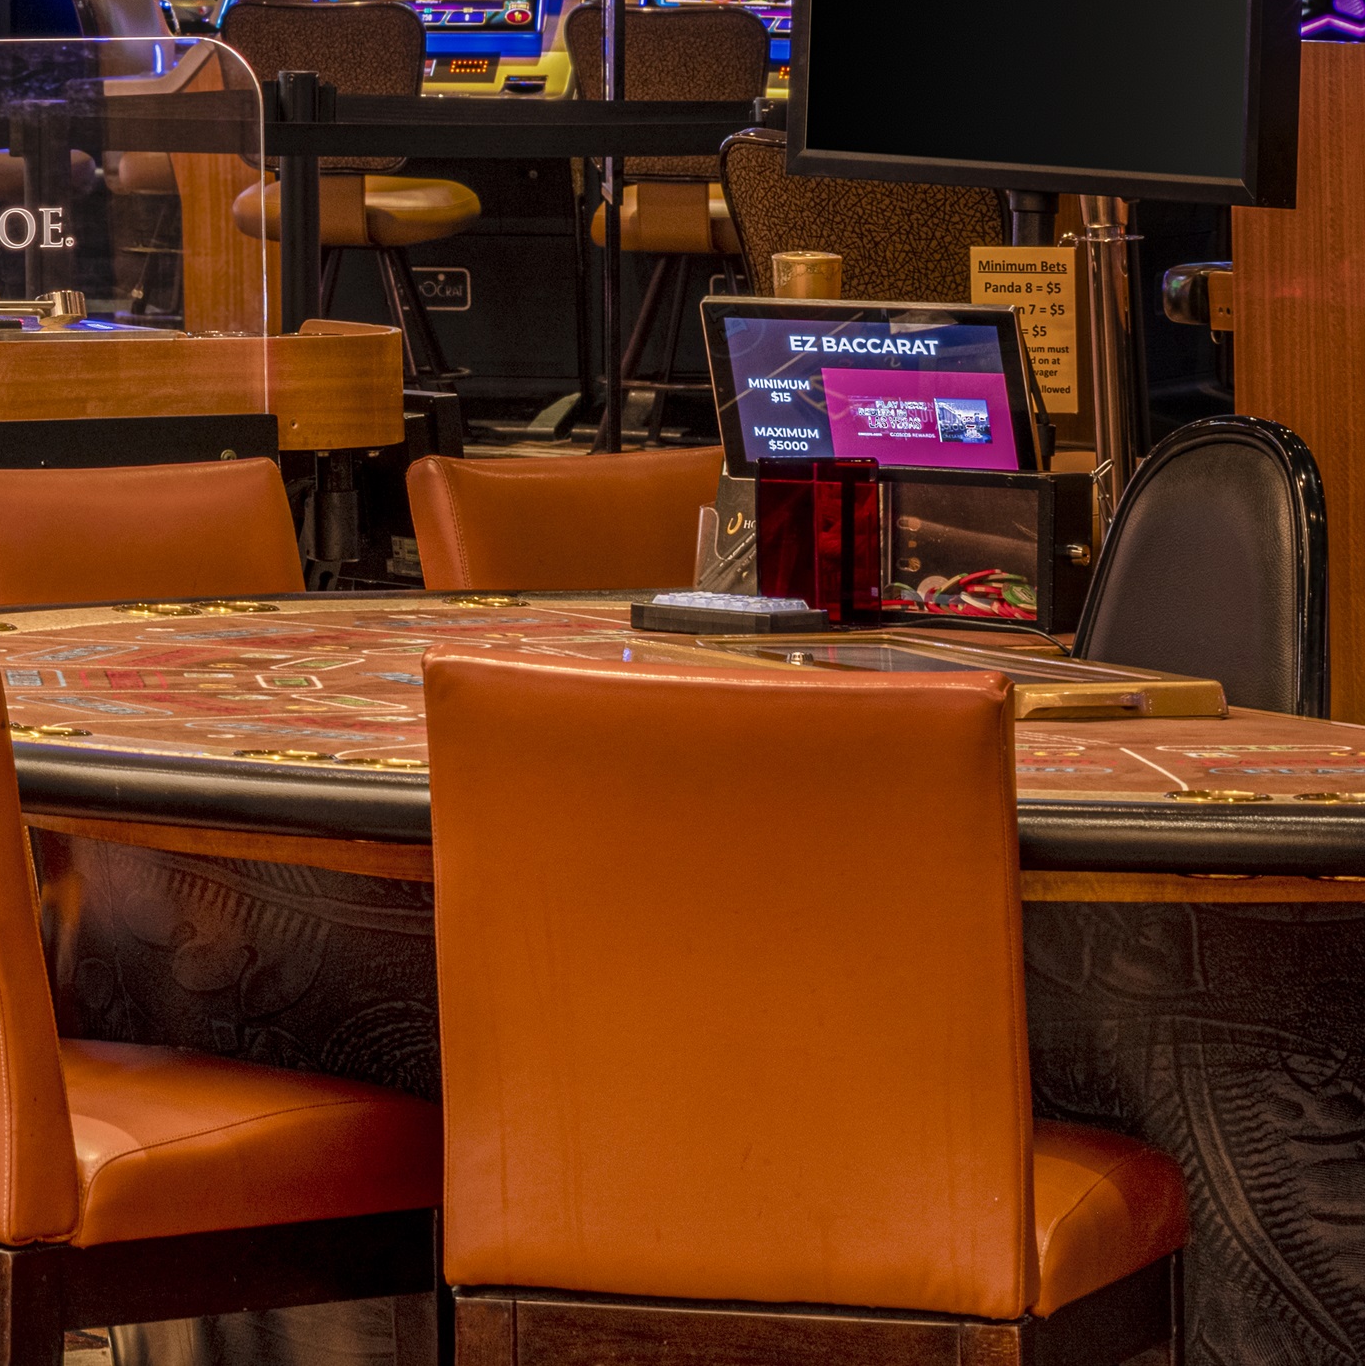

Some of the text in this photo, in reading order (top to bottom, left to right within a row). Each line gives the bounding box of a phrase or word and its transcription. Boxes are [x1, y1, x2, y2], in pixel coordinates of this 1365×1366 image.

[978, 260, 1067, 272] Minimum Bets
[984, 282, 1061, 295] Panda 8 $5
[1029, 305, 1036, 315] 7
[1050, 304, 1065, 317] $5
[1032, 325, 1047, 338] $5
[789, 336, 938, 356] EZ BACCARAT
[1048, 346, 1069, 354] must
[1052, 357, 1060, 365] at
[748, 378, 810, 390] MINIMUM
[771, 391, 791, 403] $15
[754, 426, 819, 439] MAXIMUM
[769, 439, 808, 452] $5000
